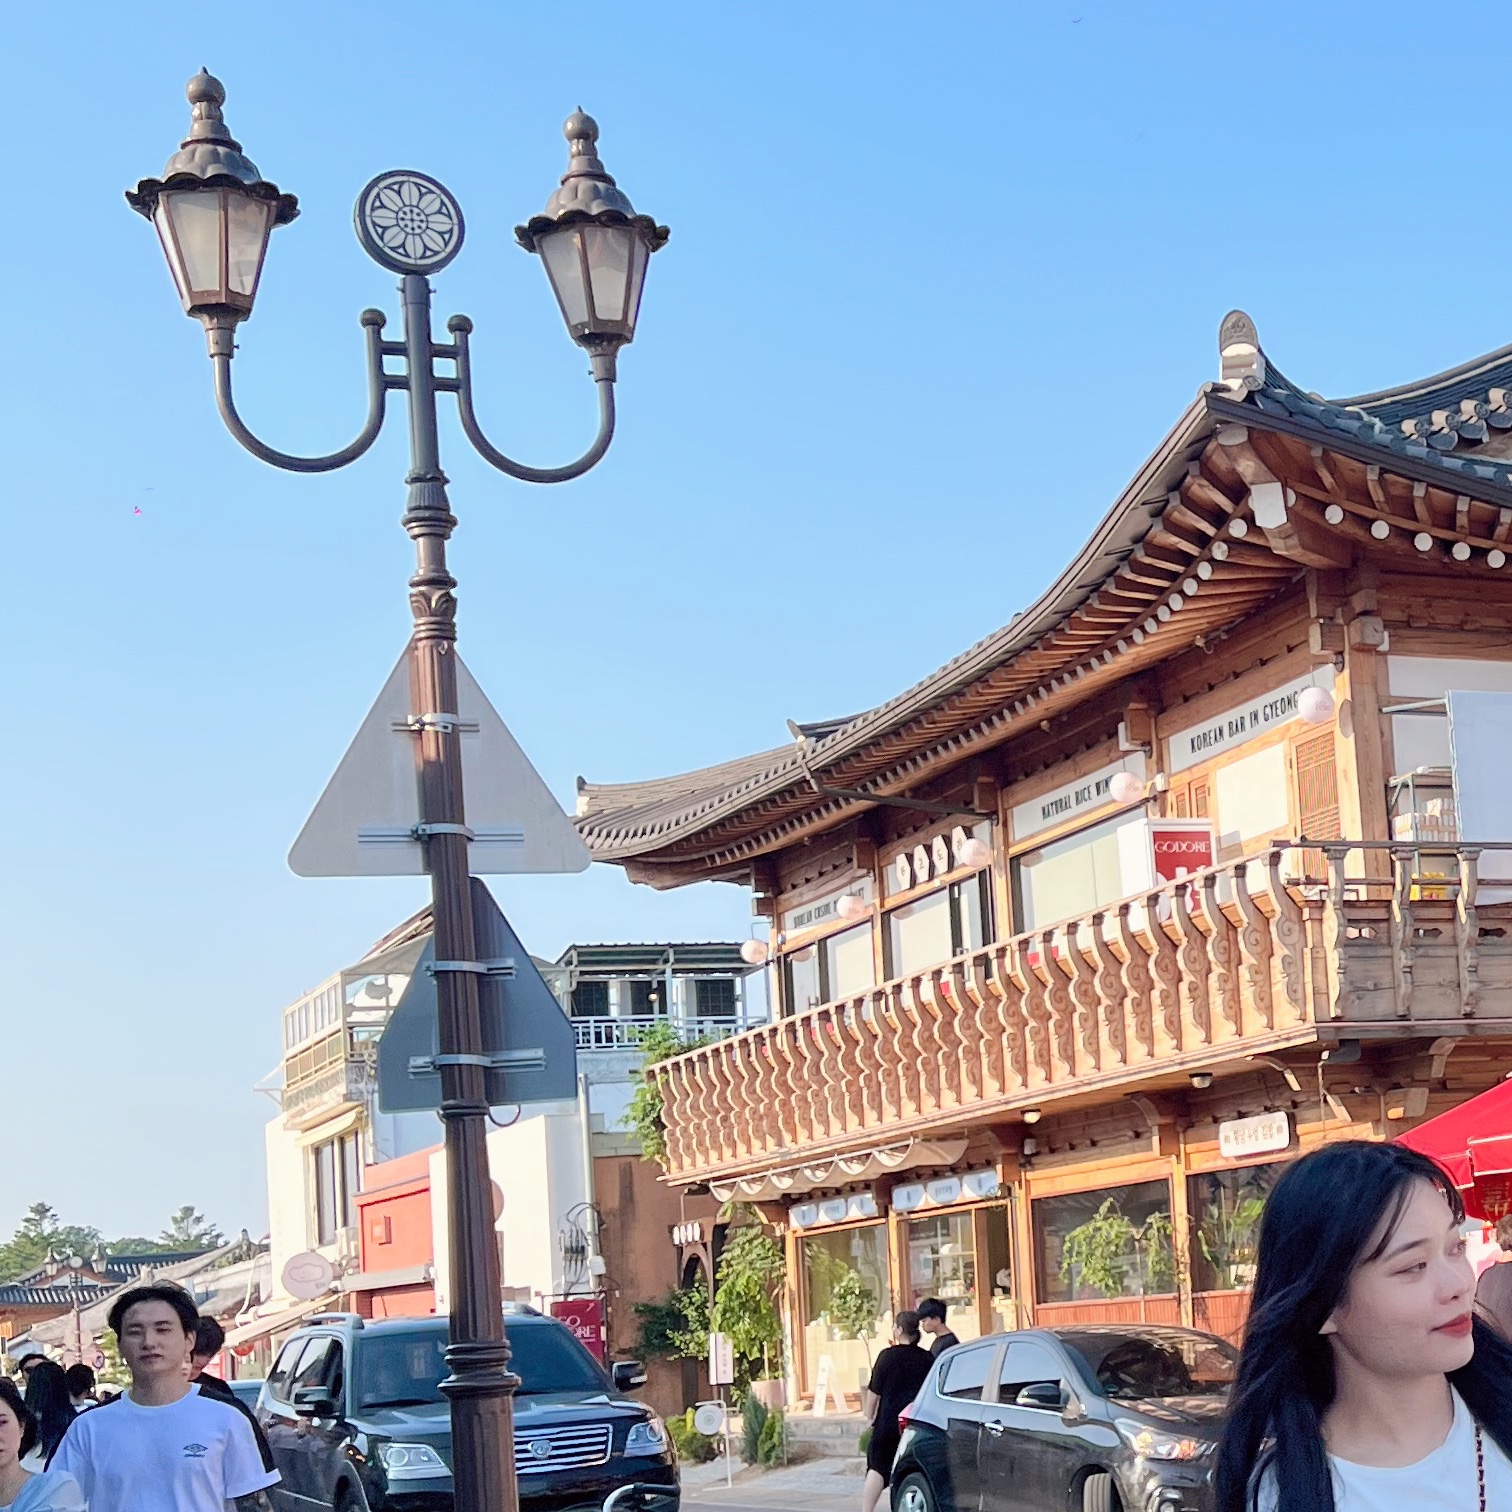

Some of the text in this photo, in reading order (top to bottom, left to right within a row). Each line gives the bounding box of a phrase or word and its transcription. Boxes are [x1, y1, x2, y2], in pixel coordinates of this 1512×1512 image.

[1190, 722, 1225, 753] KOREAN
[1228, 716, 1247, 738] BAR
[1250, 708, 1259, 728] IN
[1075, 785, 1093, 807] RICE
[1095, 774, 1114, 797] WIN
[1154, 840, 1211, 853] GODORE
